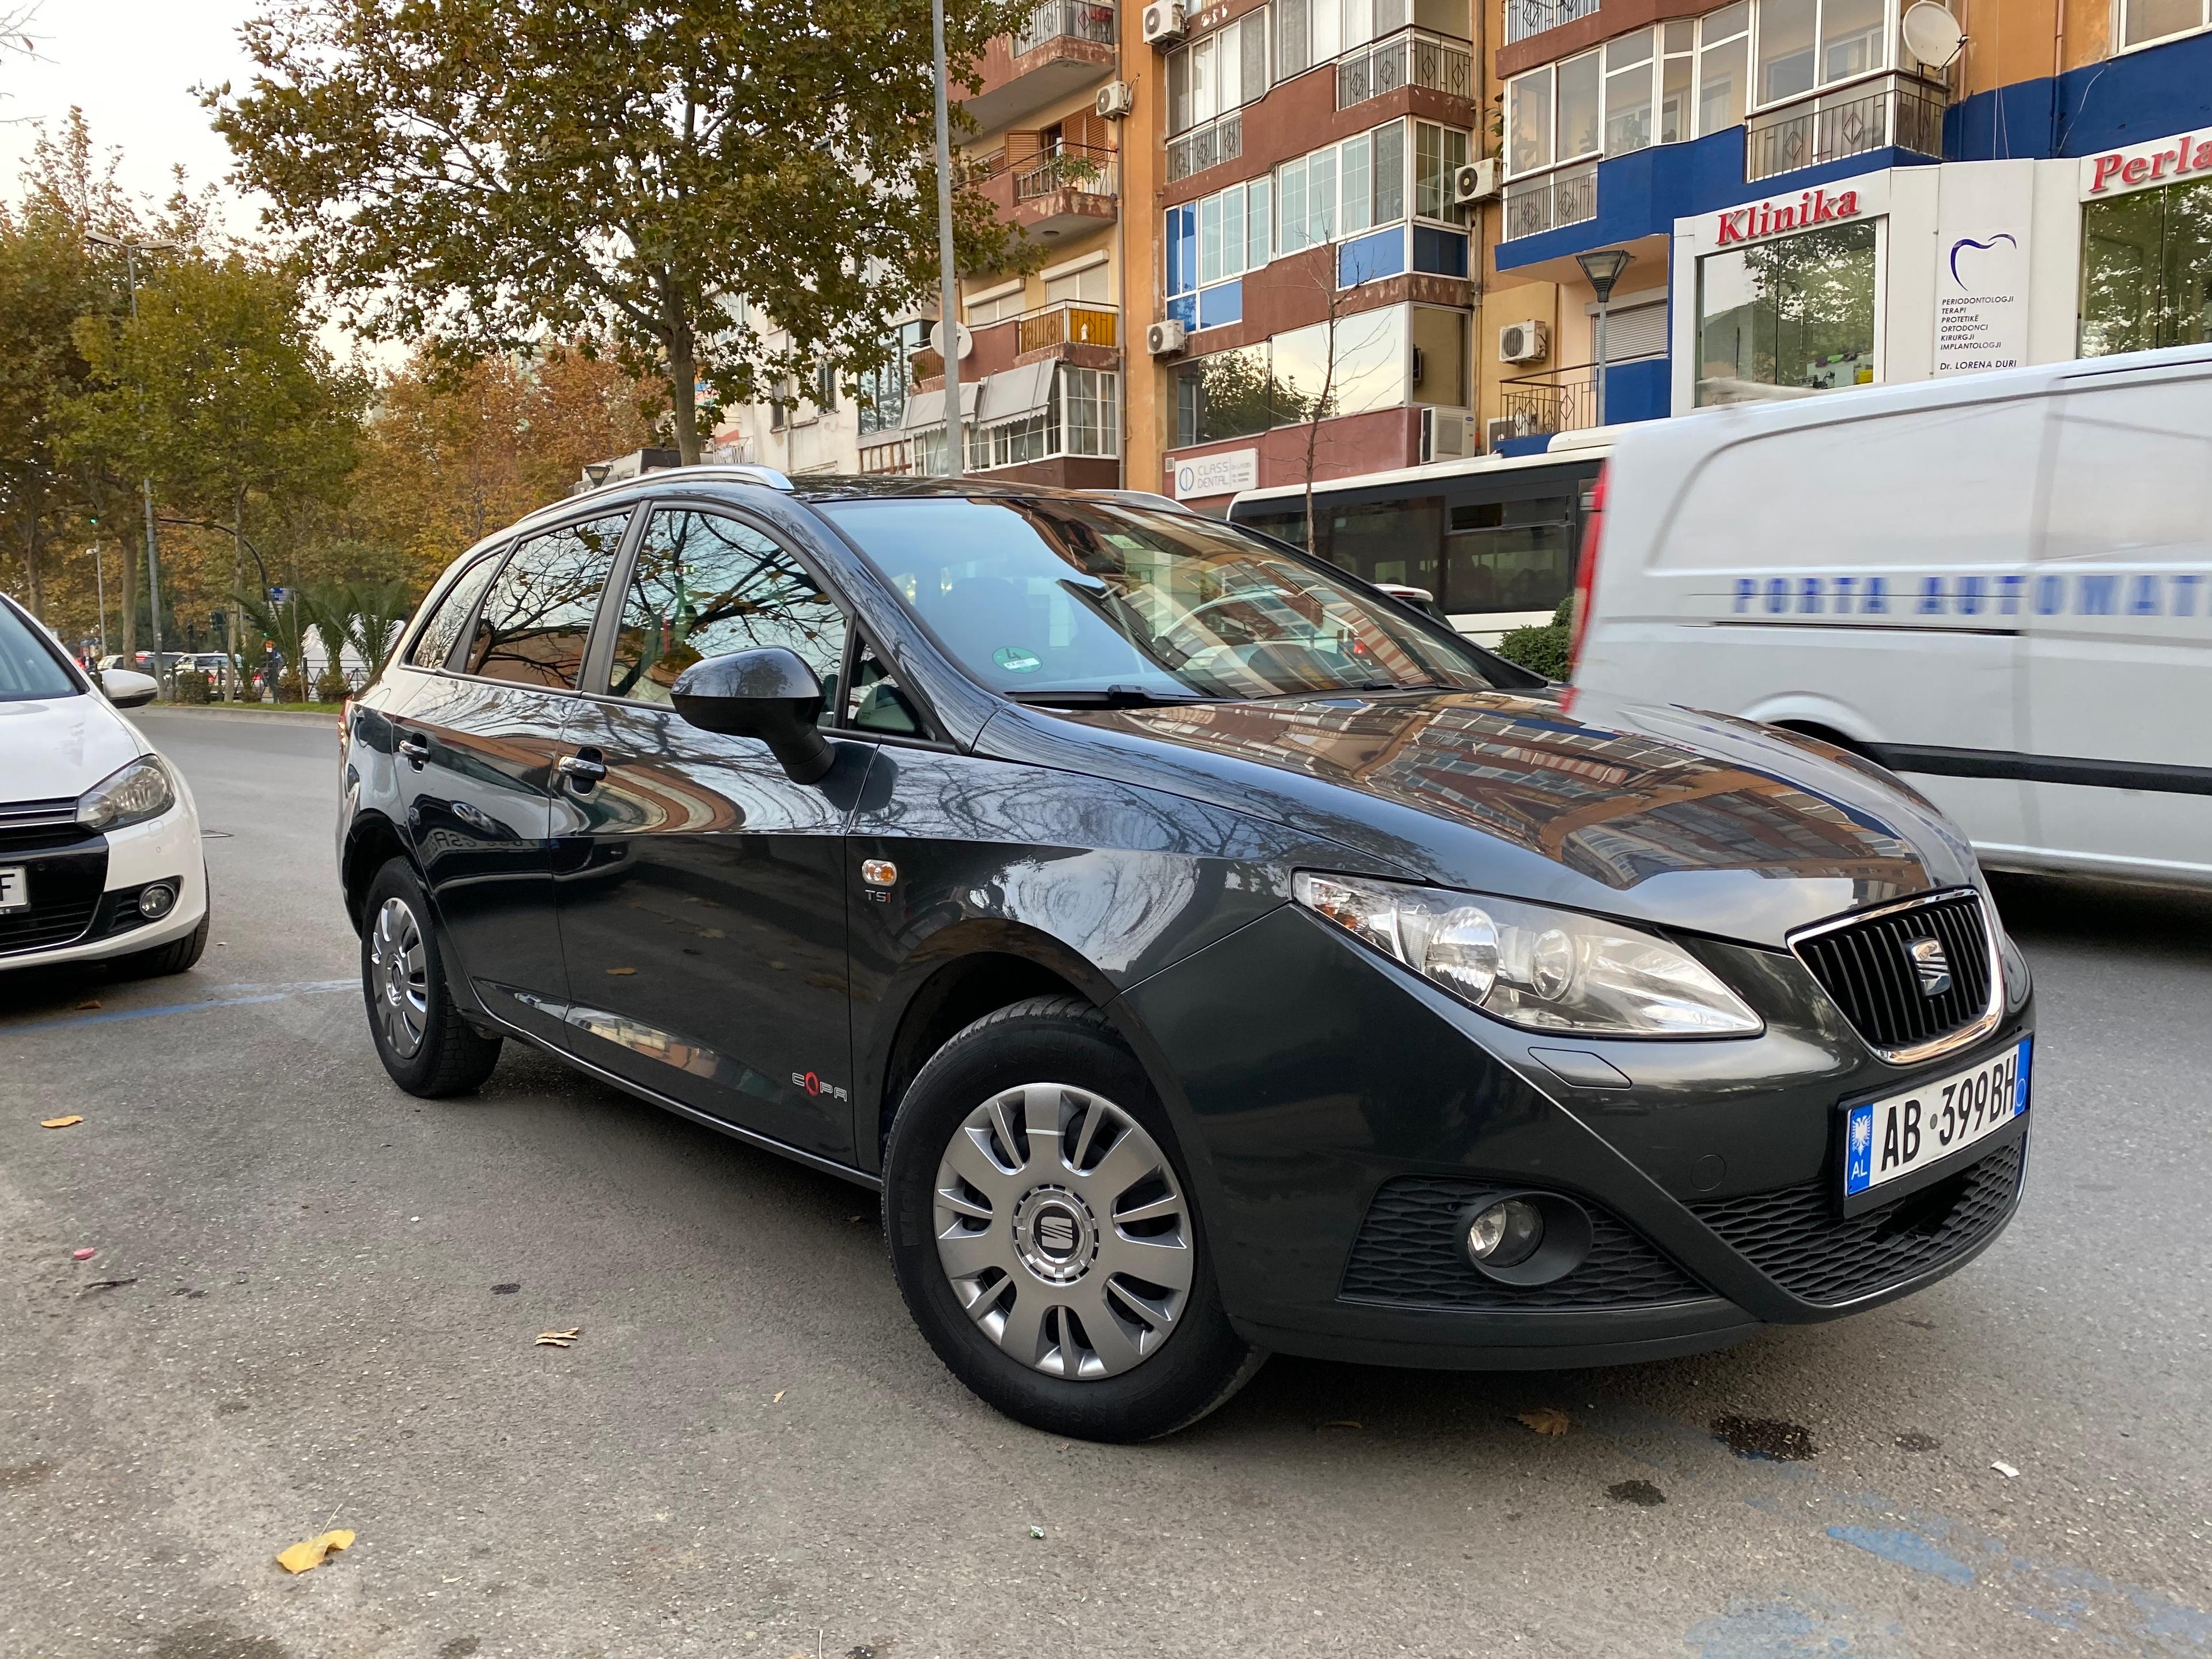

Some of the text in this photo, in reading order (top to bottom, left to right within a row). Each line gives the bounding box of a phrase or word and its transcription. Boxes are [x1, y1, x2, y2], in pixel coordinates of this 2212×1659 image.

[2089, 136, 2212, 193] Perla
[1715, 189, 1862, 245] Klinika
[1942, 296, 2014, 305] PERIODONTOLOGJI
[1941, 314, 1979, 323] PROTETIKË
[1941, 324, 1988, 332] ORTODONCI
[1940, 342, 2001, 350] IMPLANTOLOGJI
[1956, 361, 1992, 369] LORENA
[1198, 461, 1228, 476] CLASS
[1198, 475, 1229, 488] DENTAL
[865, 889, 891, 903] TSI
[1881, 1099, 1921, 1172] AB
[1851, 1160, 1868, 1180] AL
